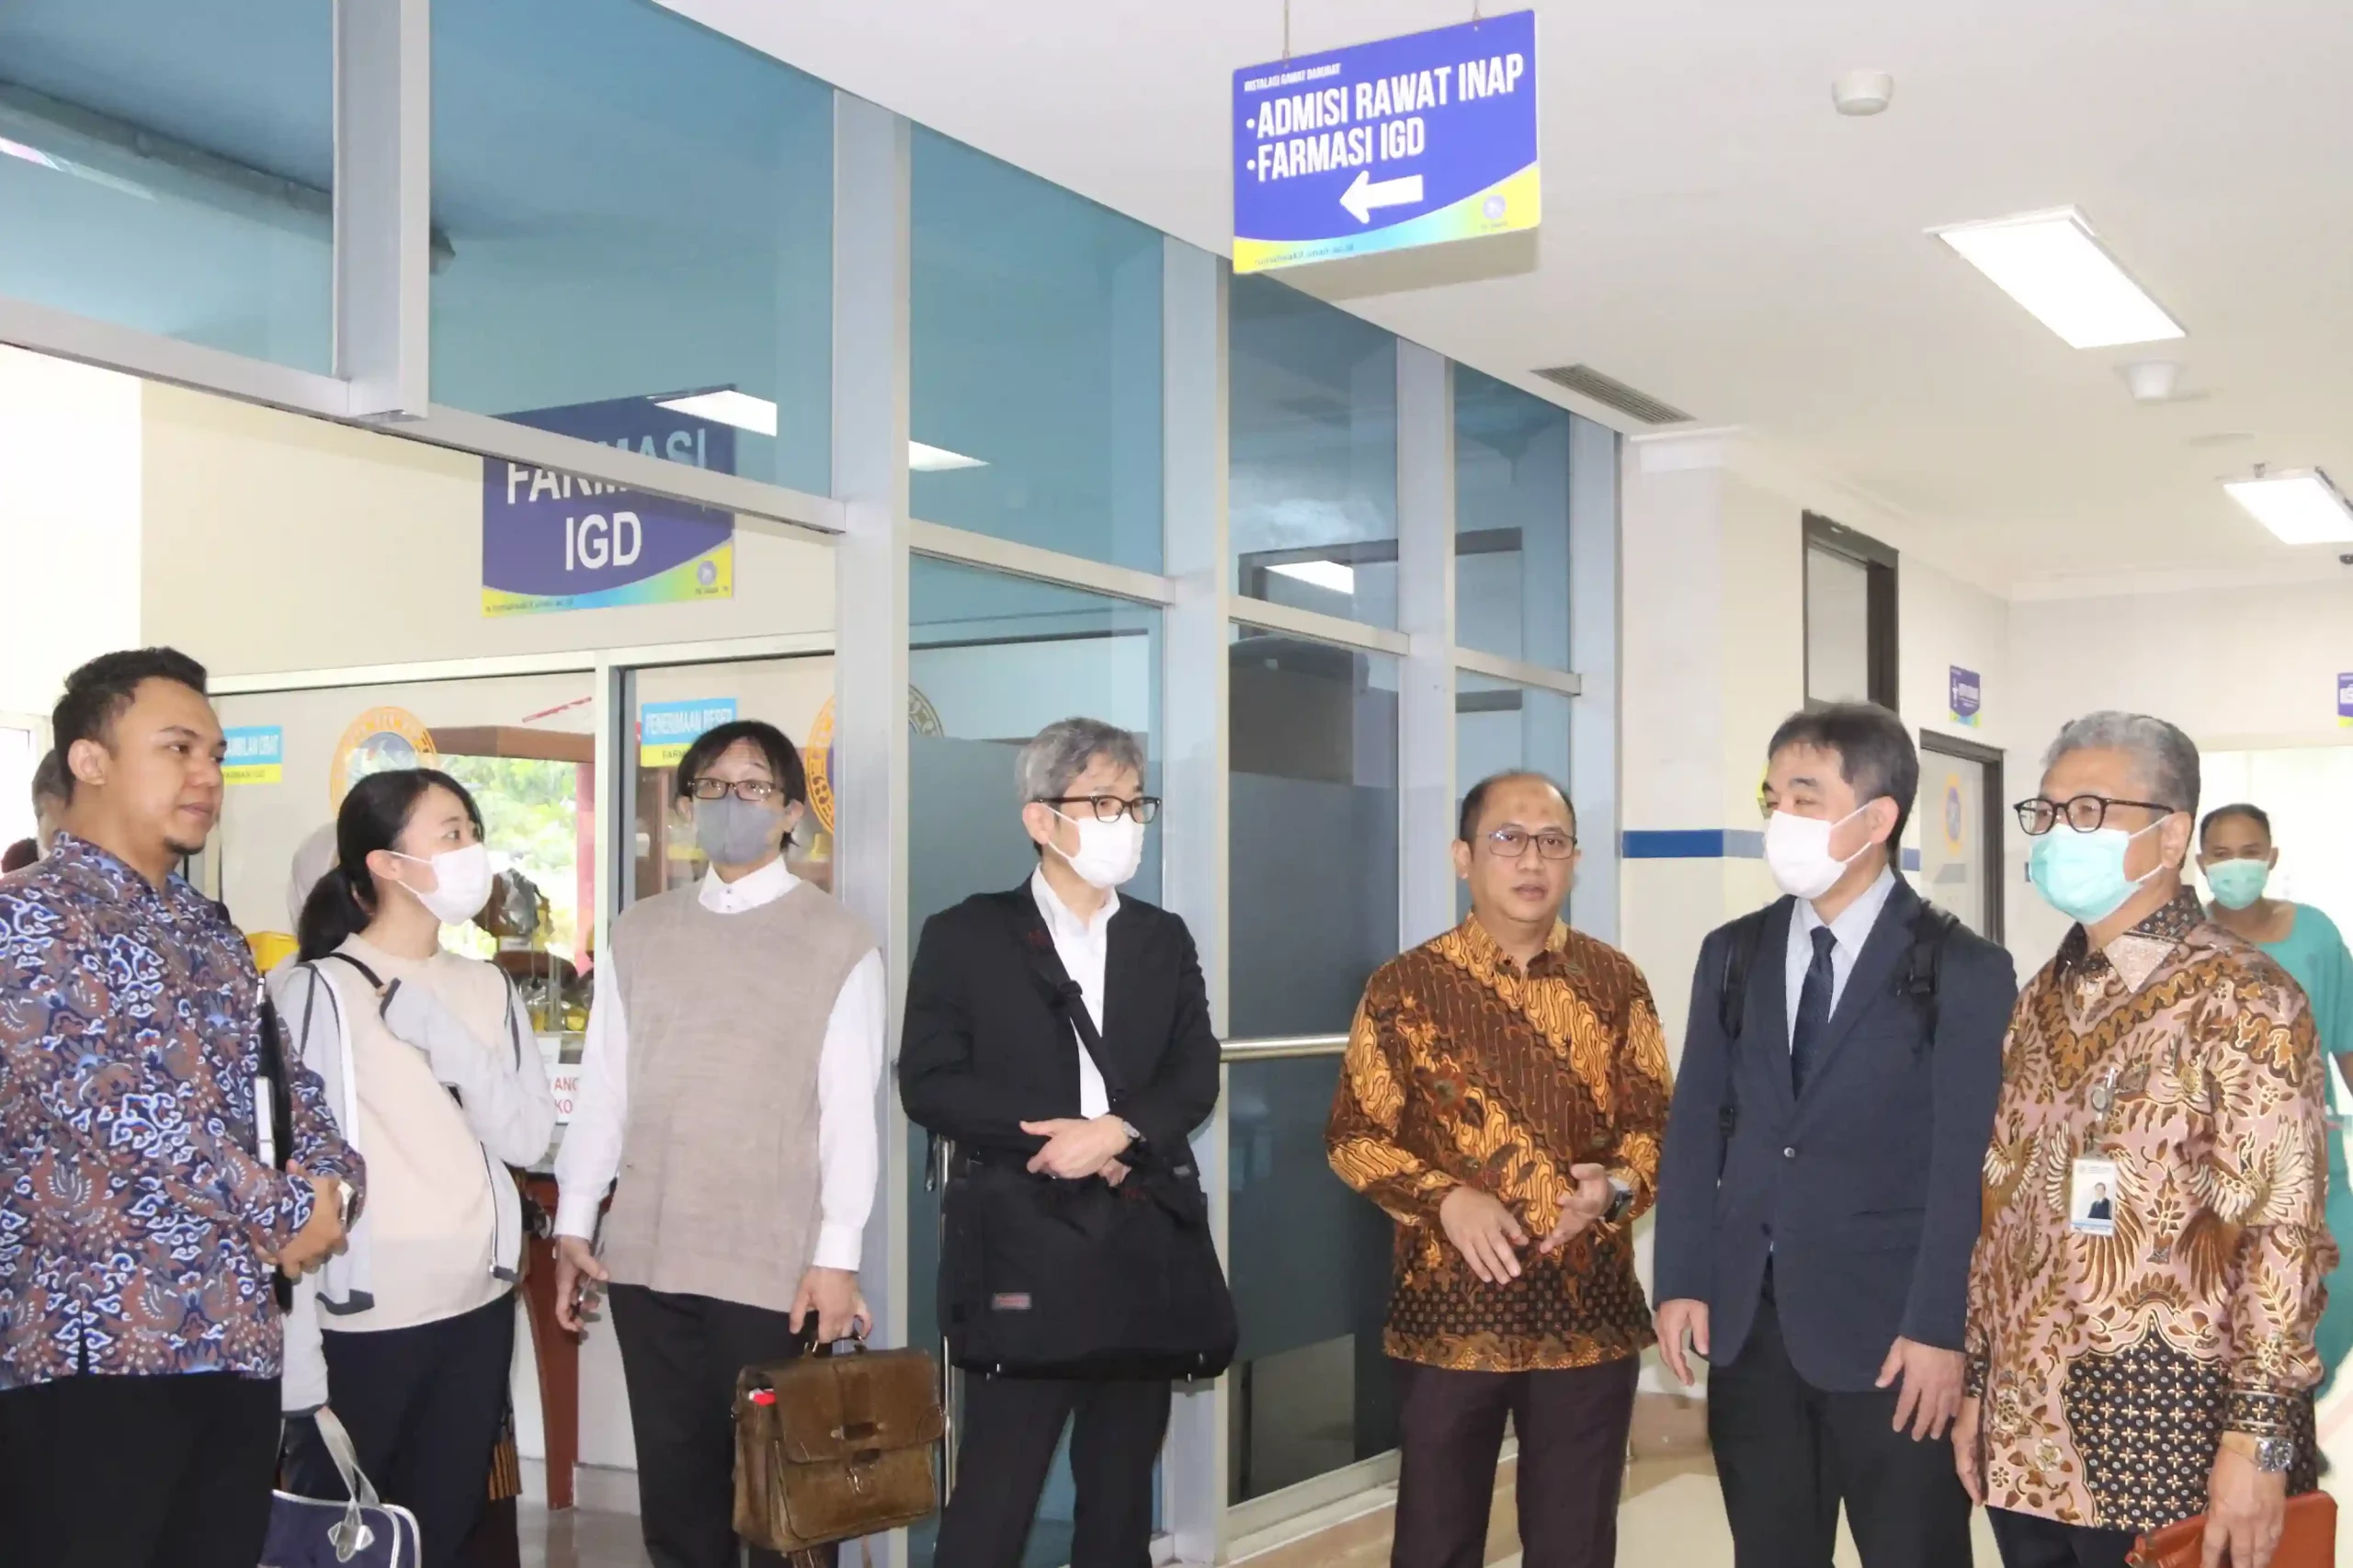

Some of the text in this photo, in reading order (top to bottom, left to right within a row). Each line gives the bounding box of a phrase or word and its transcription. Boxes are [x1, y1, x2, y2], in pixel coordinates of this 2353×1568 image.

[1257, 53, 1523, 139] ADMISI RAWAT INAP
[1258, 117, 1425, 182] FARMASI IGD
[565, 511, 642, 571] IGD
